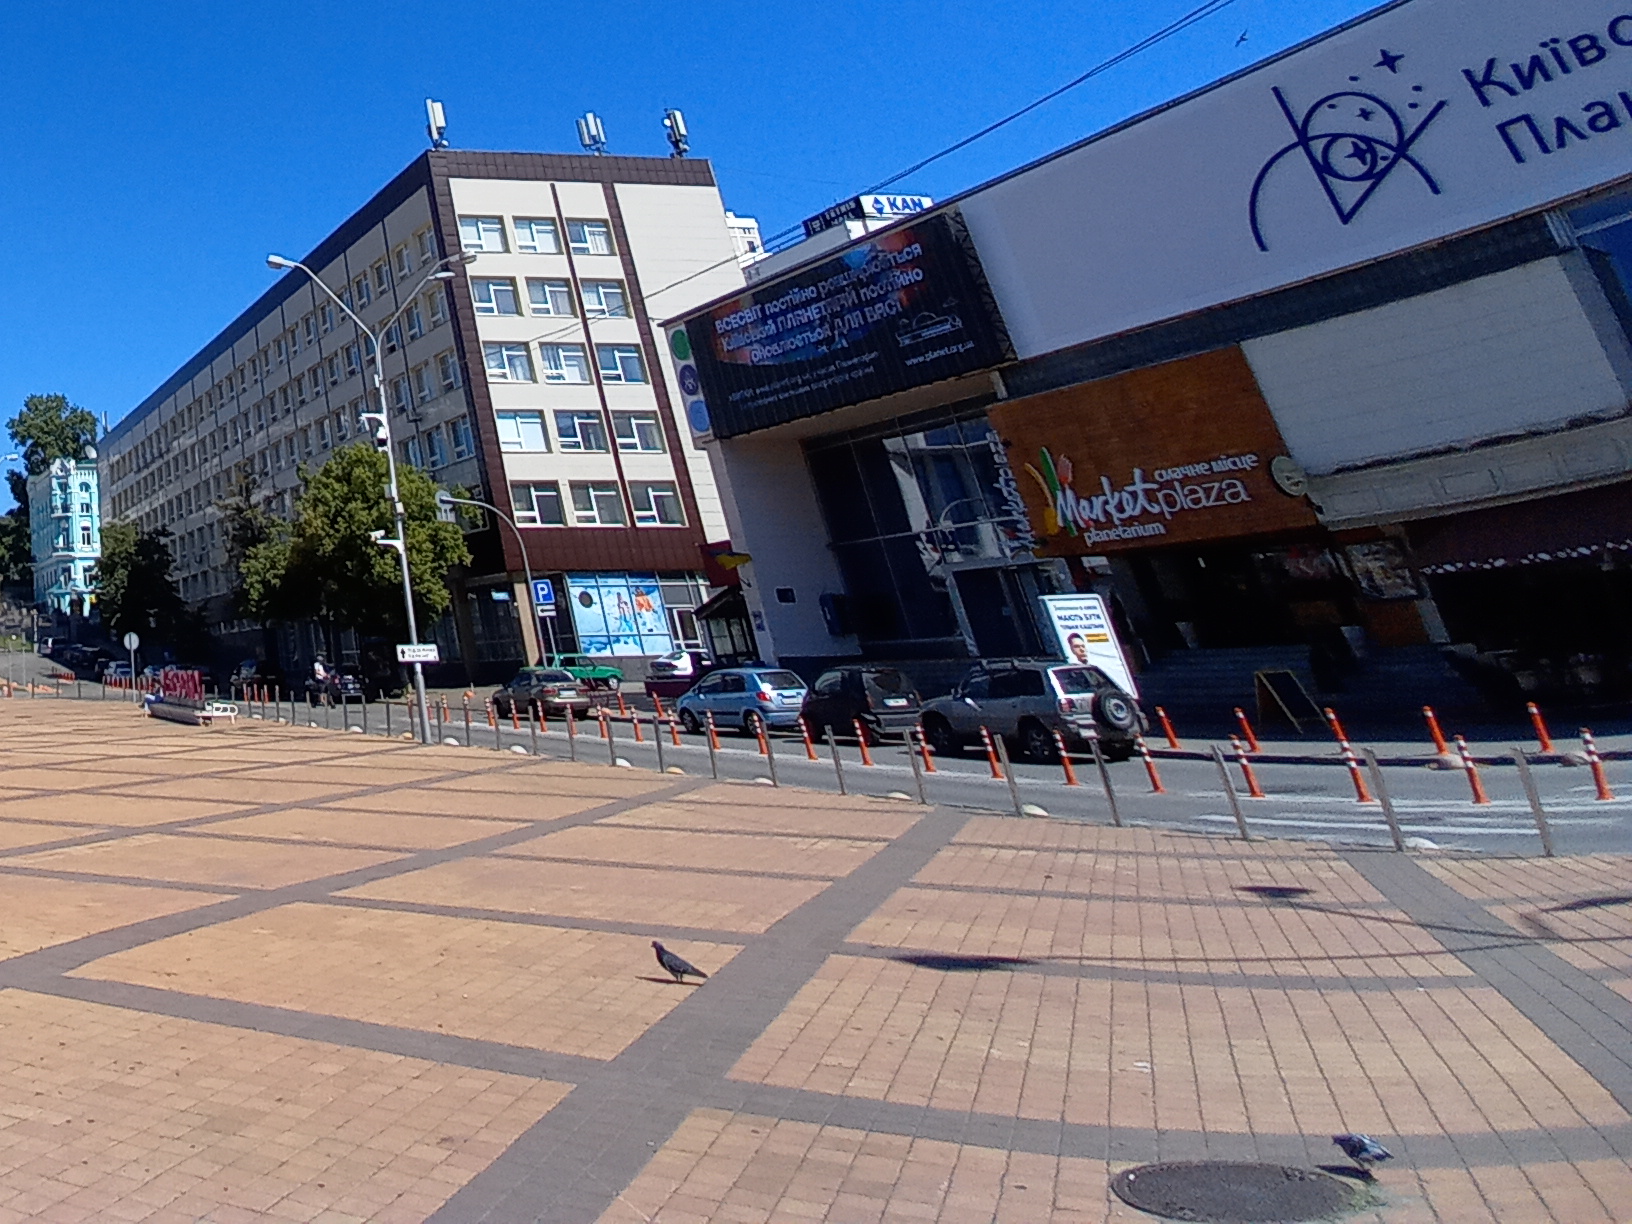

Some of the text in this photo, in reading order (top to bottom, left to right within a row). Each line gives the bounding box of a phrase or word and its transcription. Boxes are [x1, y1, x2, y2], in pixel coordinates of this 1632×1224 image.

[887, 196, 925, 212] KAN
[715, 304, 763, 334] ВСЕСВІТ
[764, 286, 817, 316] постійно
[1154, 462, 1211, 481] смачне
[1055, 468, 1252, 528] Market plaza
[1083, 521, 1166, 547] planetarium
[536, 583, 549, 603] P
